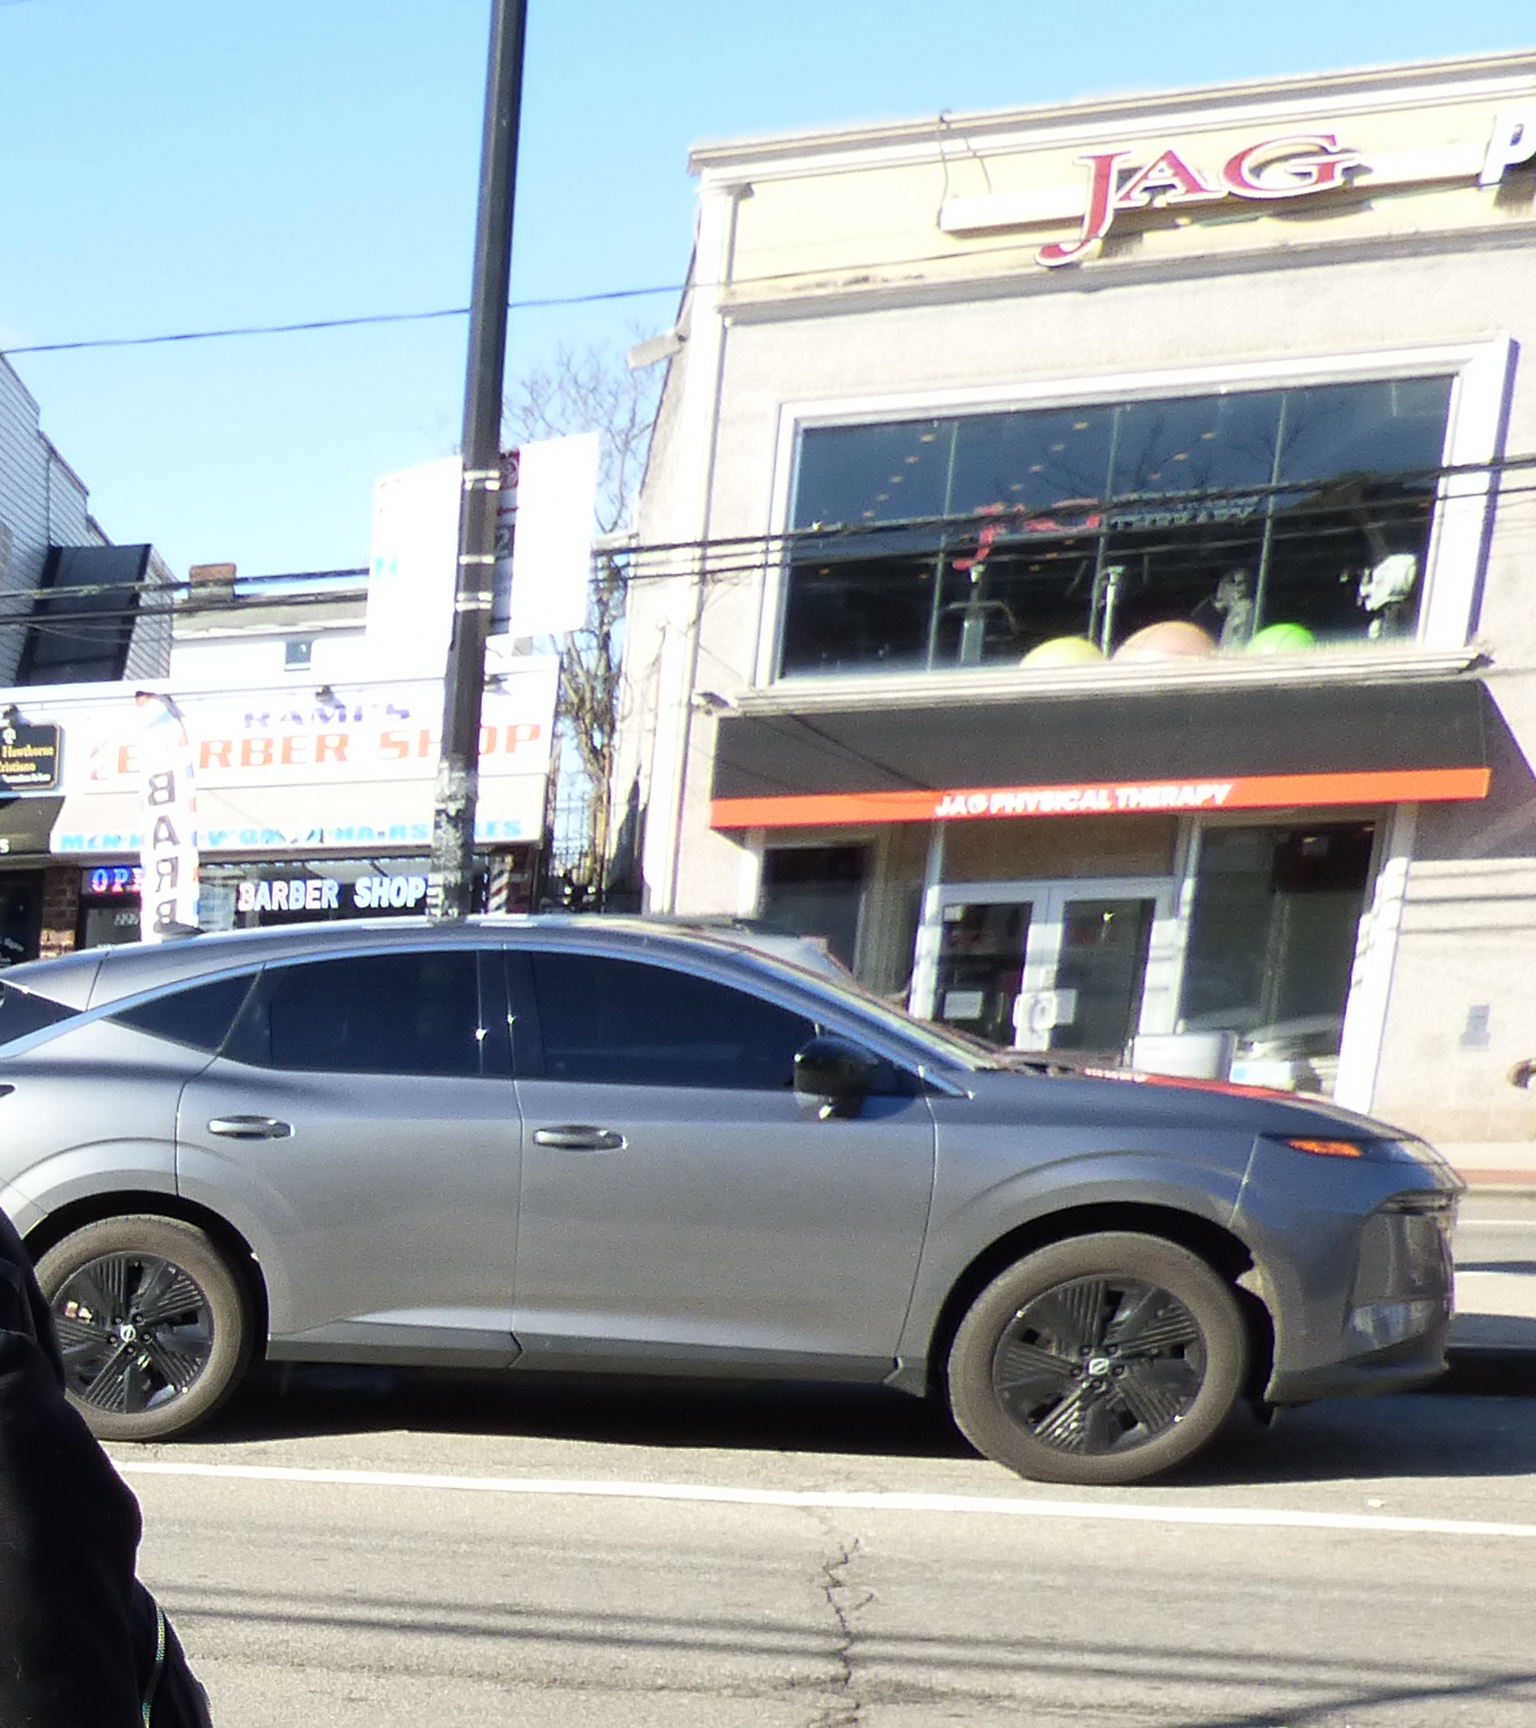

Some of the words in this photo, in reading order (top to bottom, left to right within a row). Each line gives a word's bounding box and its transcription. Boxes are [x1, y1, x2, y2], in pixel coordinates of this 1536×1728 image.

[1035, 133, 1356, 268] JAG
[935, 794, 989, 816] JAG
[990, 789, 1111, 813] PHYSICAL
[1115, 783, 1233, 807] THERAPY
[238, 879, 339, 911] BARBER
[354, 876, 427, 908] SHOP
